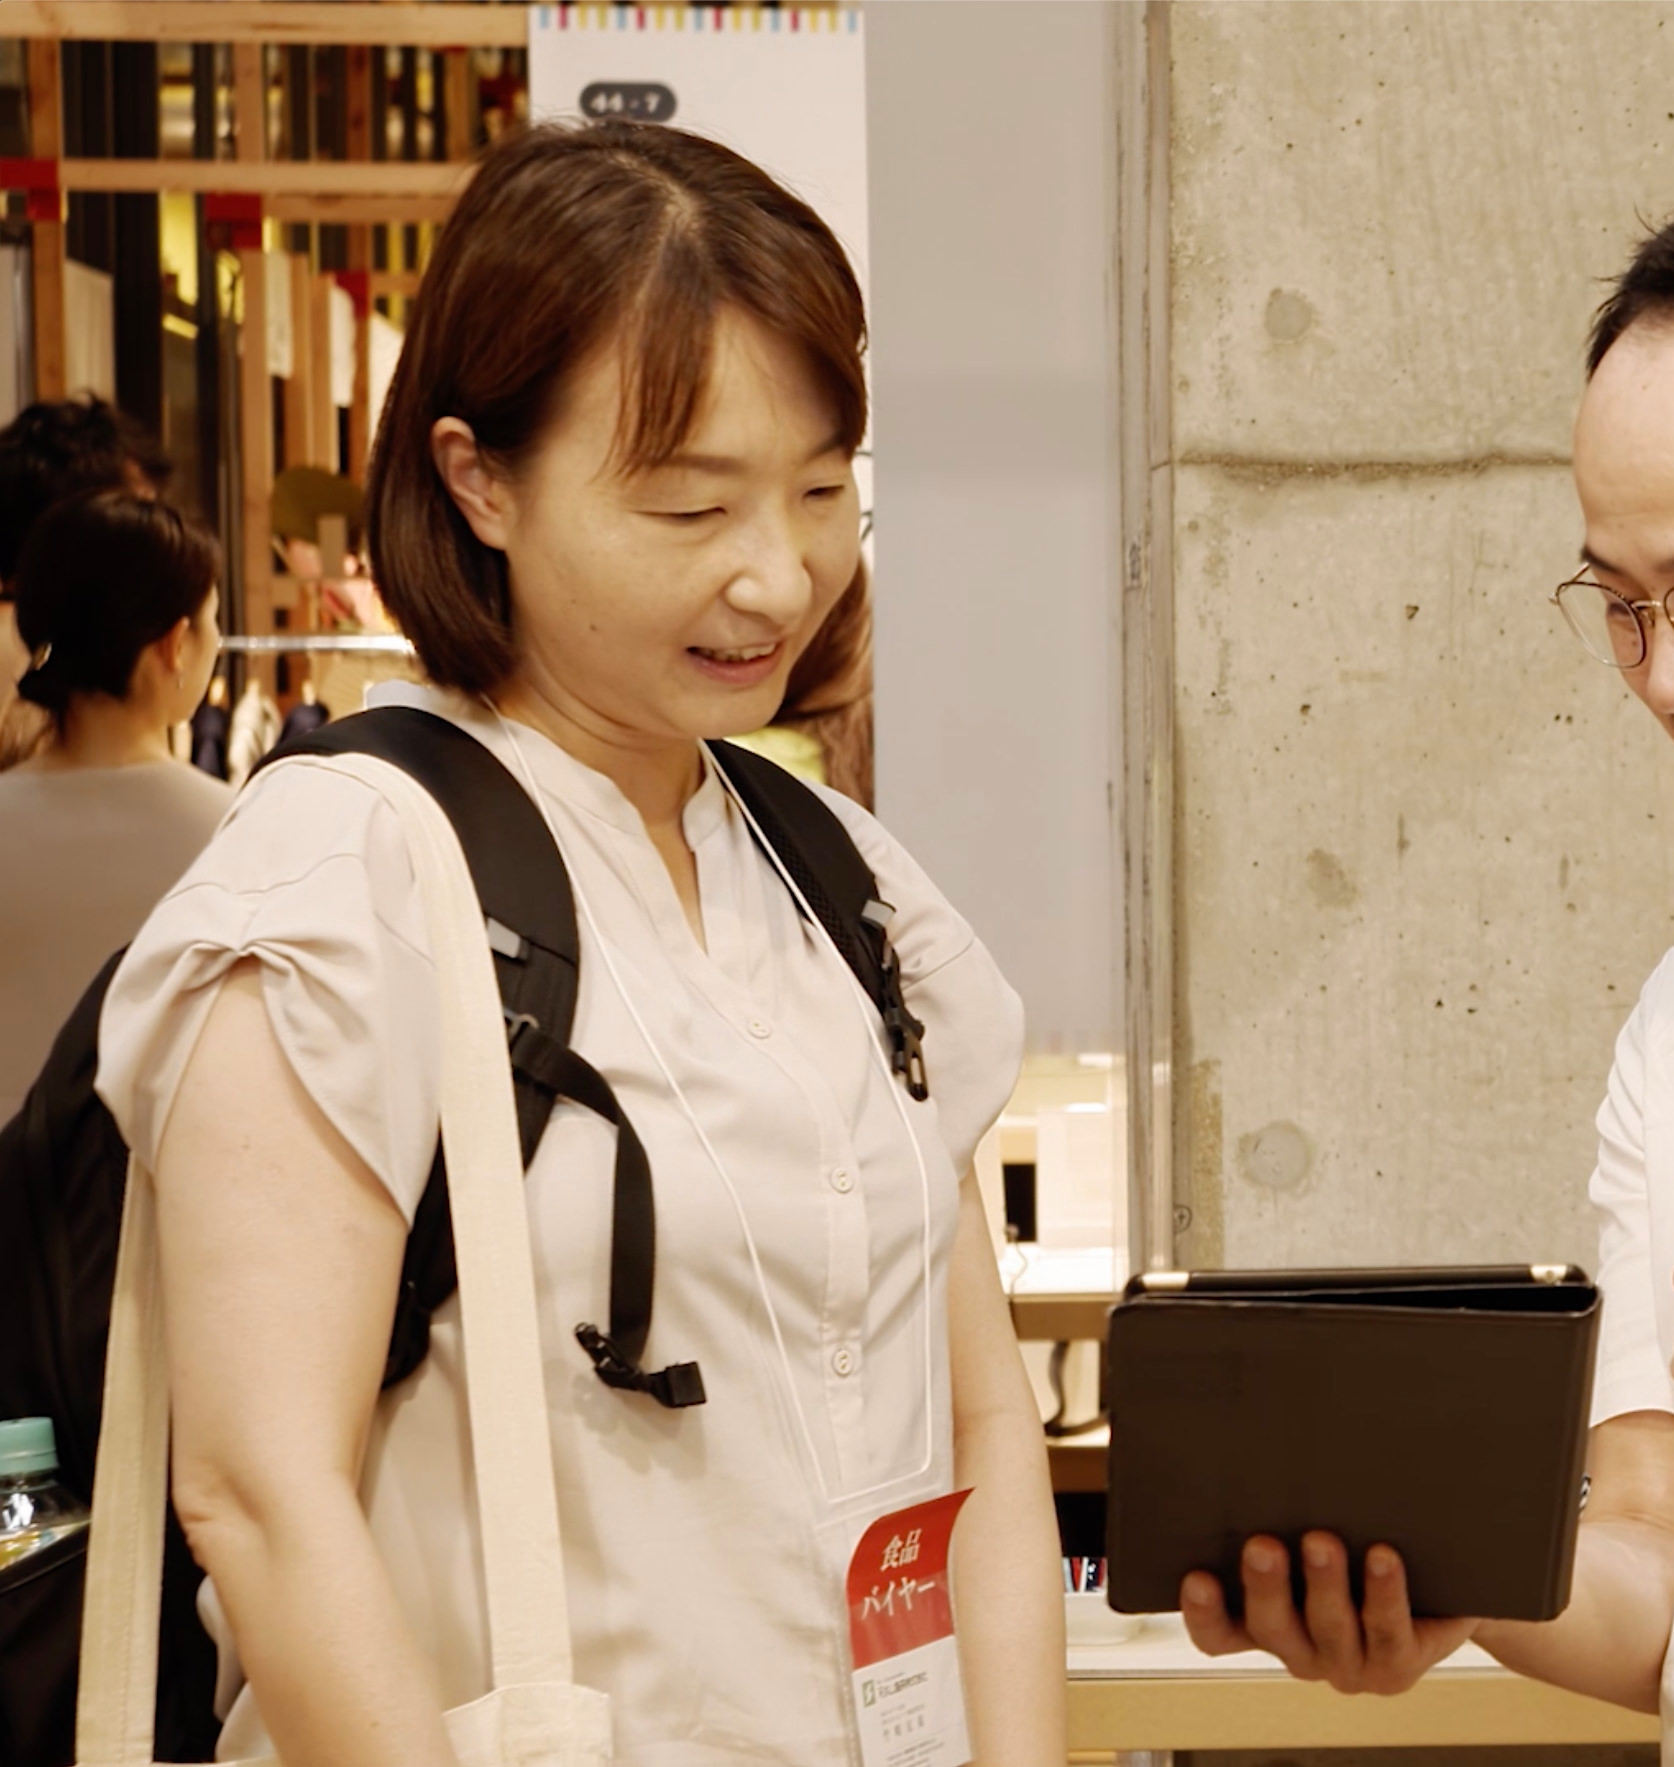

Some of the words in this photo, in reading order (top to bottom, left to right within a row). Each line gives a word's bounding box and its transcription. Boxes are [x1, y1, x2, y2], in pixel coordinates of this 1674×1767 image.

[880, 1528, 922, 1572] 食品
[862, 1577, 935, 1620] バイヤー
